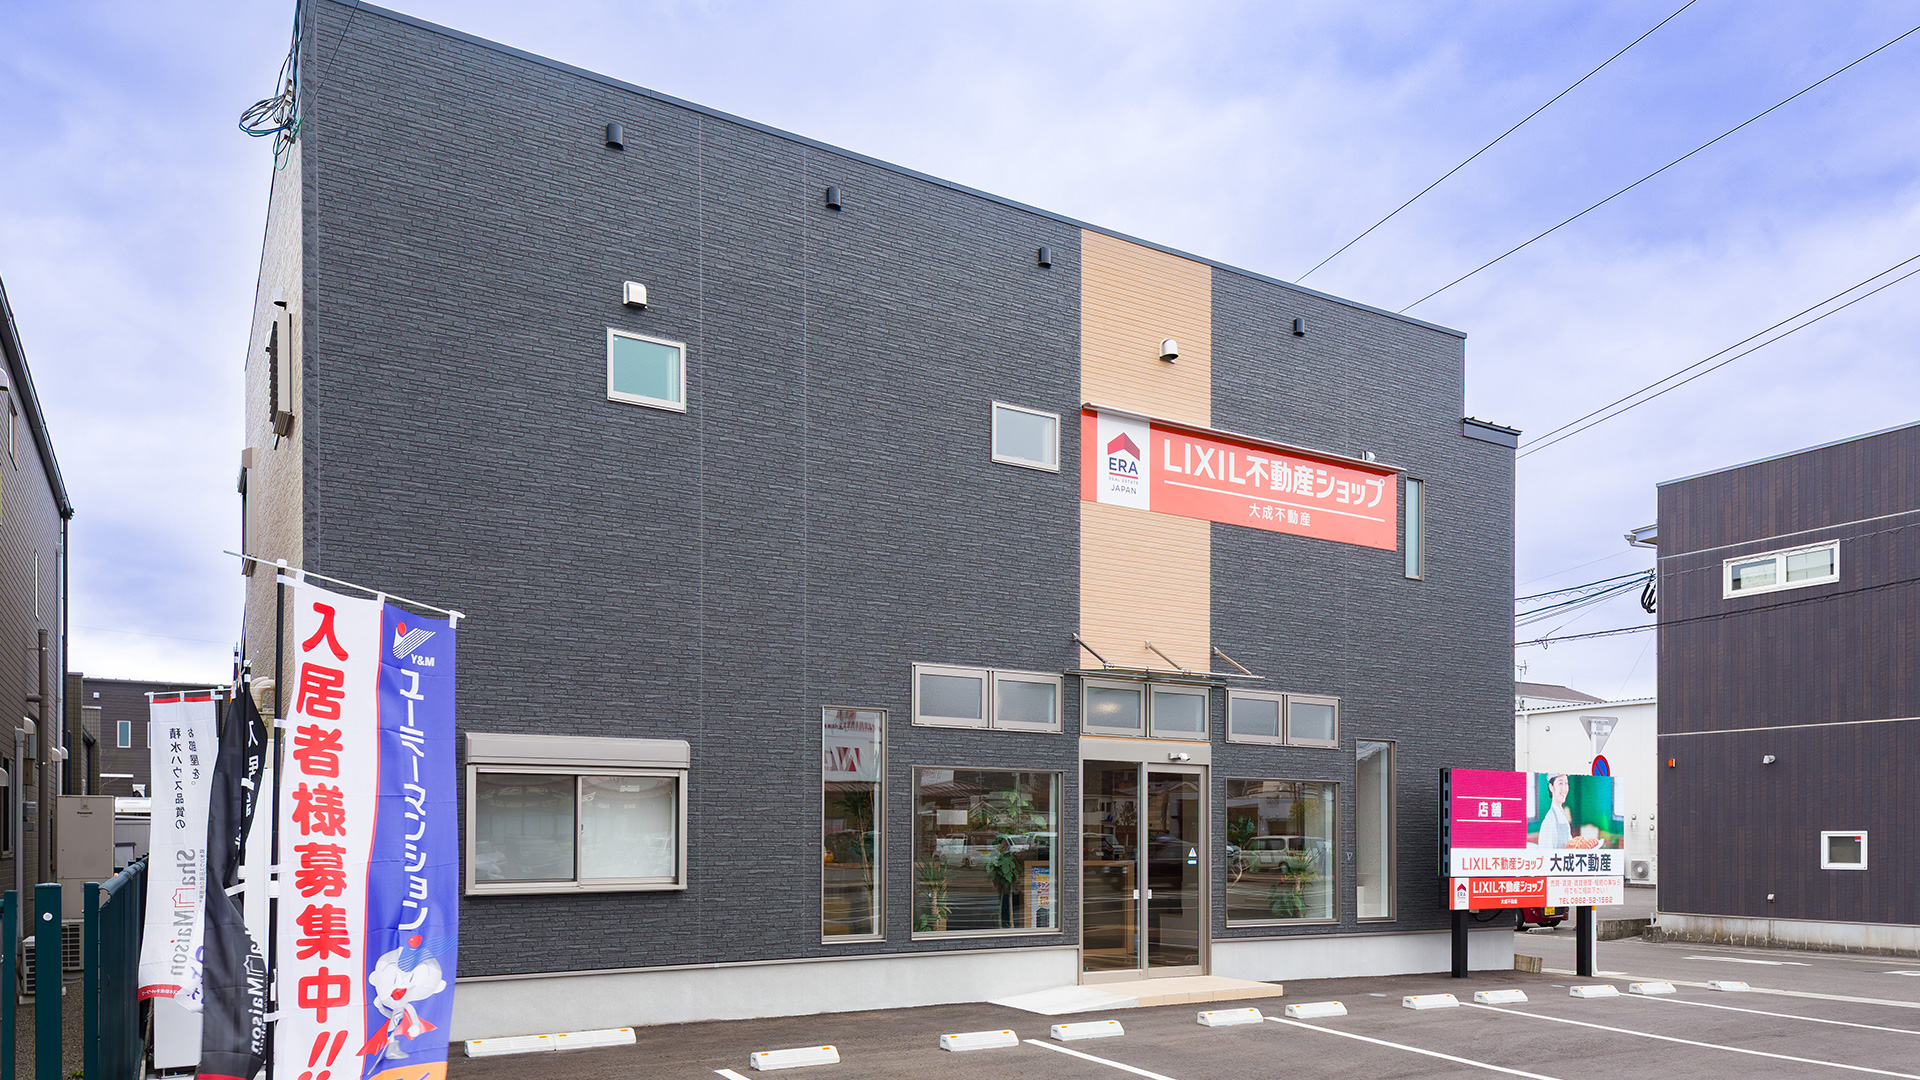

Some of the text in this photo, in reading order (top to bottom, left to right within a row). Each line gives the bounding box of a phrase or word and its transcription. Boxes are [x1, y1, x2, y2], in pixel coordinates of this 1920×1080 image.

[1109, 457, 1138, 475] ERA
[1163, 438, 1386, 508] LIXIL不動産ショップ
[1111, 484, 1137, 495] JAPAN
[1248, 503, 1312, 527] 大成不動産
[411, 653, 435, 667] Y&M
[398, 668, 428, 931] ユーミーマンション
[1478, 801, 1502, 817] 店舗
[1462, 853, 1611, 872] LIXIL不動産ショップ 大成不動産
[1473, 879, 1544, 893] LIXIL不動産ショップ
